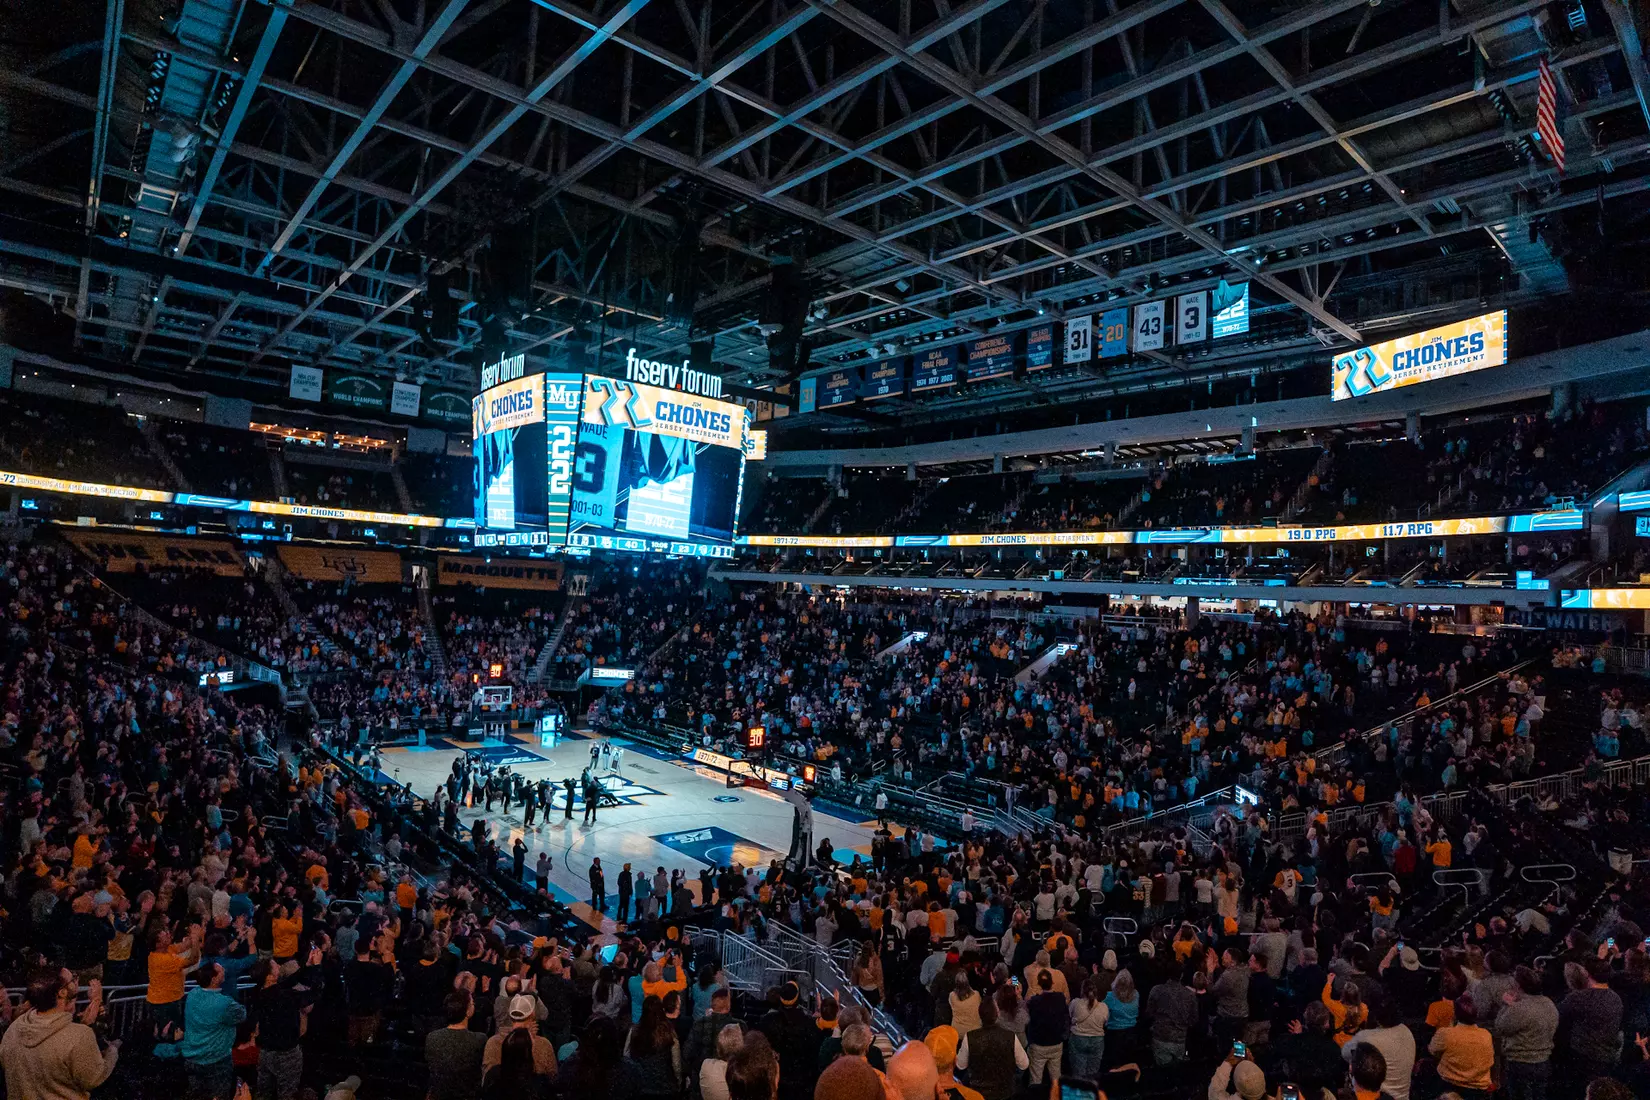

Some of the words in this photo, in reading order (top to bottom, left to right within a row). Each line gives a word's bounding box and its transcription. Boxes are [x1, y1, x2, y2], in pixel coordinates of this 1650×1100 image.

[1186, 296, 1199, 304] WADE
[1184, 306, 1200, 330] 3
[1106, 324, 1124, 342] 20
[1140, 316, 1160, 336] 43
[1070, 328, 1088, 350] 31
[970, 344, 1012, 360] CHAMPIONSHIPS
[1392, 332, 1484, 372] CHONES
[1336, 346, 1392, 398] 22
[1393, 368, 1422, 380] JERSEY
[1426, 354, 1485, 372] RETIREMENT
[928, 376, 939, 386] 1977
[940, 374, 953, 382] 2003
[352, 396, 383, 406] CHAMPIONS
[491, 389, 533, 419] CHONES
[549, 384, 578, 410] MU
[591, 378, 653, 428] 22
[832, 395, 842, 404] 1977
[760, 402, 768, 412] 14
[656, 401, 730, 433] CHONES
[580, 421, 608, 440] WADE
[655, 422, 683, 432] JERSEY
[686, 427, 730, 440] RETIREMENT
[574, 440, 608, 494] 3
[290, 506, 308, 515] JIM
[310, 508, 345, 518] CHONES
[1287, 530, 1311, 540] 19.0
[1315, 528, 1336, 540] PPG
[1382, 524, 1404, 536] 11.7
[1406, 522, 1433, 535] RPG
[624, 540, 638, 549] 40
[980, 536, 994, 544] JIM
[996, 535, 1026, 544] CHONES
[442, 561, 558, 581] MARQUETTE
[750, 735, 762, 746] 30
[698, 750, 718, 763] 1971-72
[1287, 879, 1293, 887] 3
[1132, 890, 1144, 900] 33
[775, 904, 782, 912] 3
[859, 910, 870, 918] 33
